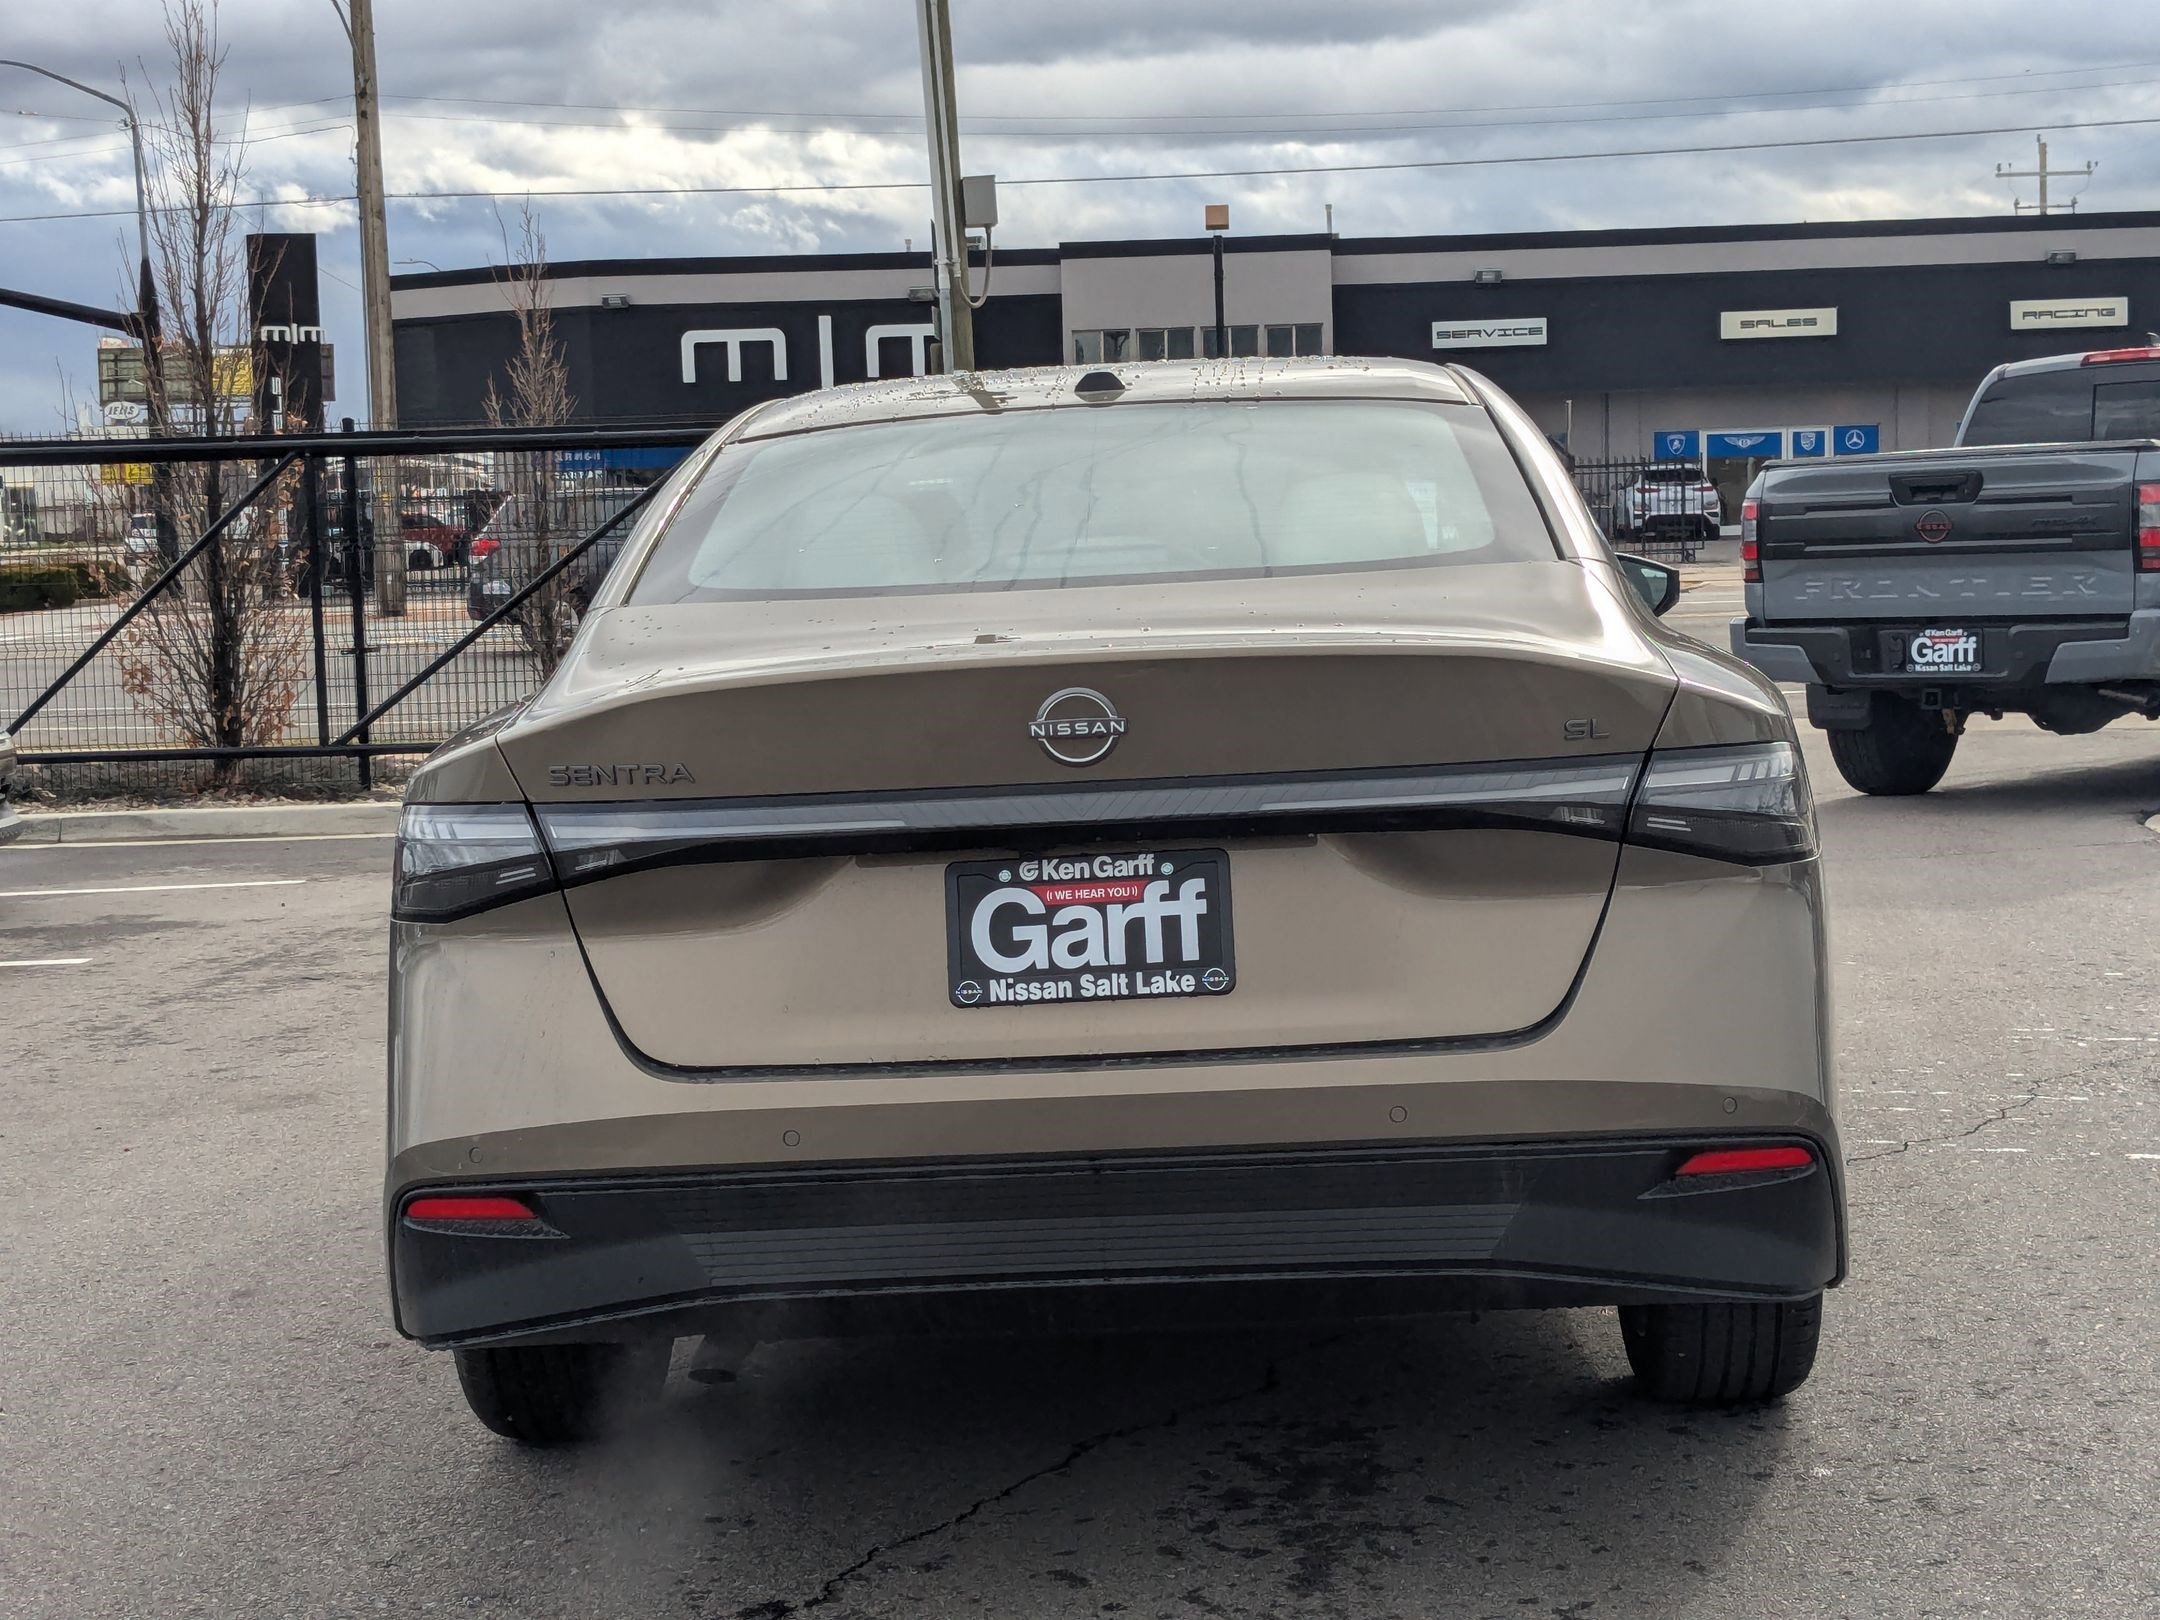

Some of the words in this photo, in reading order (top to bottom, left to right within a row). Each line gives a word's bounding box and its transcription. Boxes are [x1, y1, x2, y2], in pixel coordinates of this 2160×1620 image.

[1740, 317, 1818, 329] SALES
[2022, 307, 2116, 320] RACING
[1436, 326, 1543, 339] SERVICE
[1795, 573, 2097, 600] FRONTIER
[1911, 636, 1977, 664] Garff
[1030, 720, 1125, 737] NISSAN
[1564, 718, 1610, 741] SL
[548, 763, 696, 787] SENTRA
[1042, 858, 1090, 881] Ken
[1092, 853, 1155, 879] Garff
[1054, 890, 1073, 900] WE
[1075, 888, 1105, 900] HEAR
[1107, 887, 1130, 898] YOU
[971, 878, 1208, 974] Garff
[989, 978, 1073, 1002] Nissan
[1080, 972, 1129, 998] Salt
[1136, 970, 1196, 995] Lake
